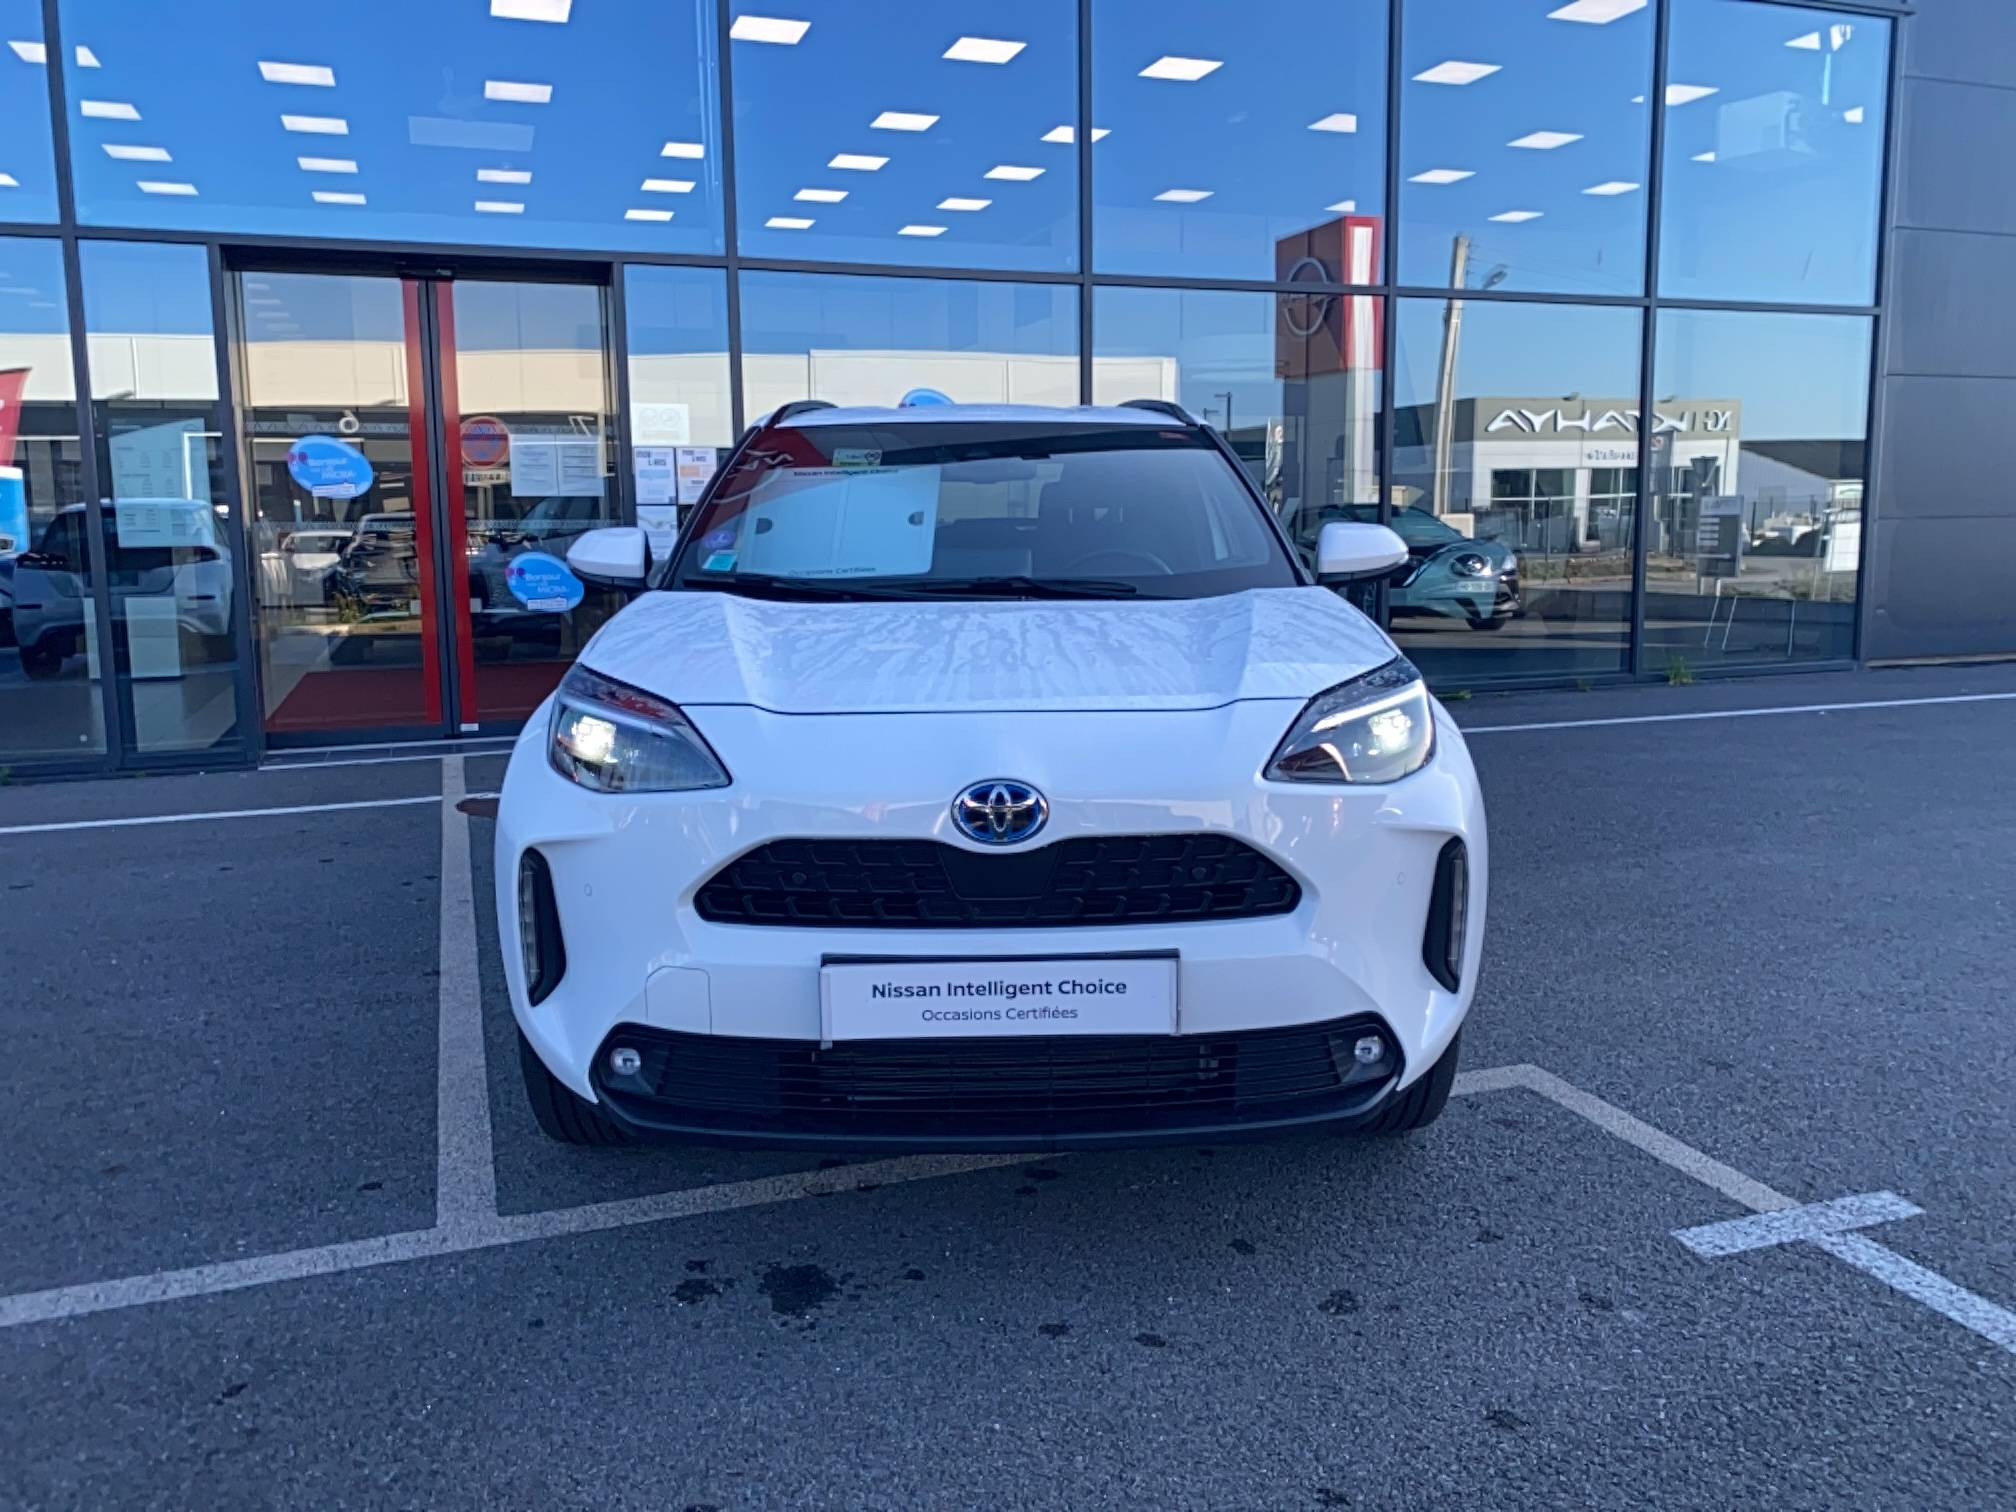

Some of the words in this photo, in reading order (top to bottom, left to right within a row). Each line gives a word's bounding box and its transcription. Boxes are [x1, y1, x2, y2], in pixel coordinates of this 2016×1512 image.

[872, 981, 941, 999] Nissan
[947, 979, 1053, 1000] Intelligent
[1058, 978, 1128, 995] Choice
[922, 1008, 1002, 1022] Occasions
[1005, 1005, 1078, 1021] Certifiées
